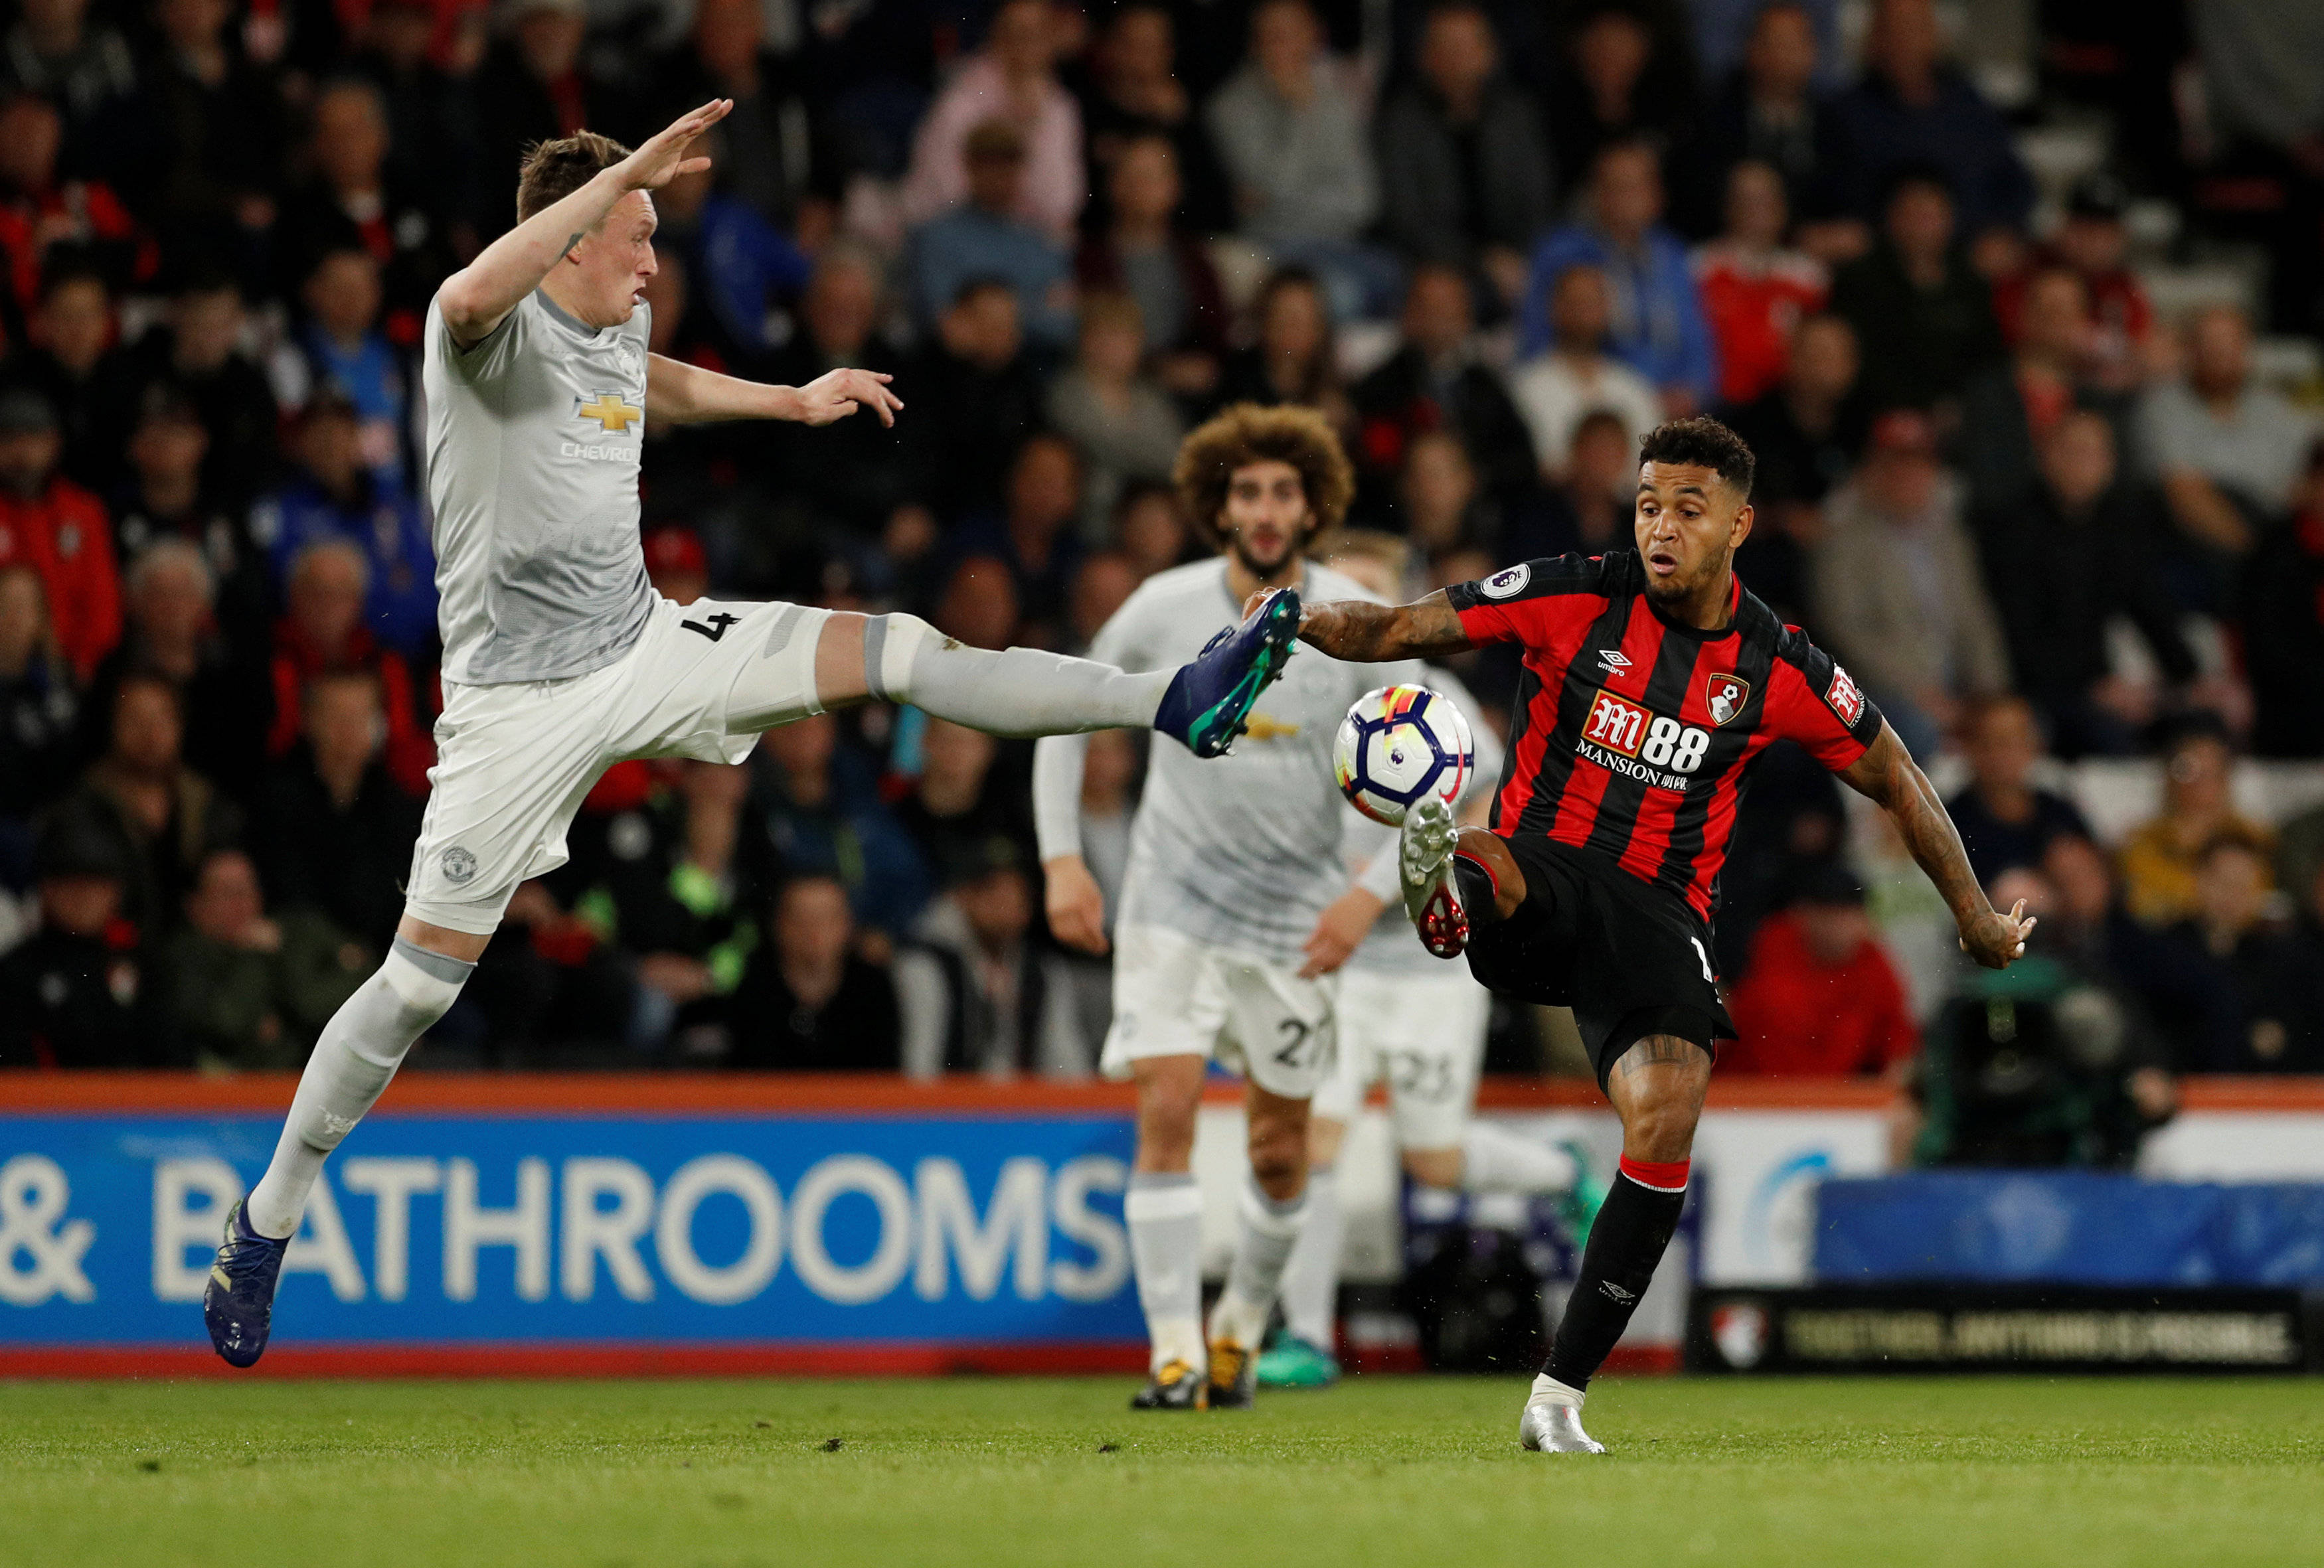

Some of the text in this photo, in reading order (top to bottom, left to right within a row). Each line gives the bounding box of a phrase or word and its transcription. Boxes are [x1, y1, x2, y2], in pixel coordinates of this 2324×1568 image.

[680, 611, 743, 643] 4
[1598, 661, 1625, 677] umbro
[1575, 738, 1662, 786] MANSION
[0, 1154, 1129, 1306] & BATHROOMS
